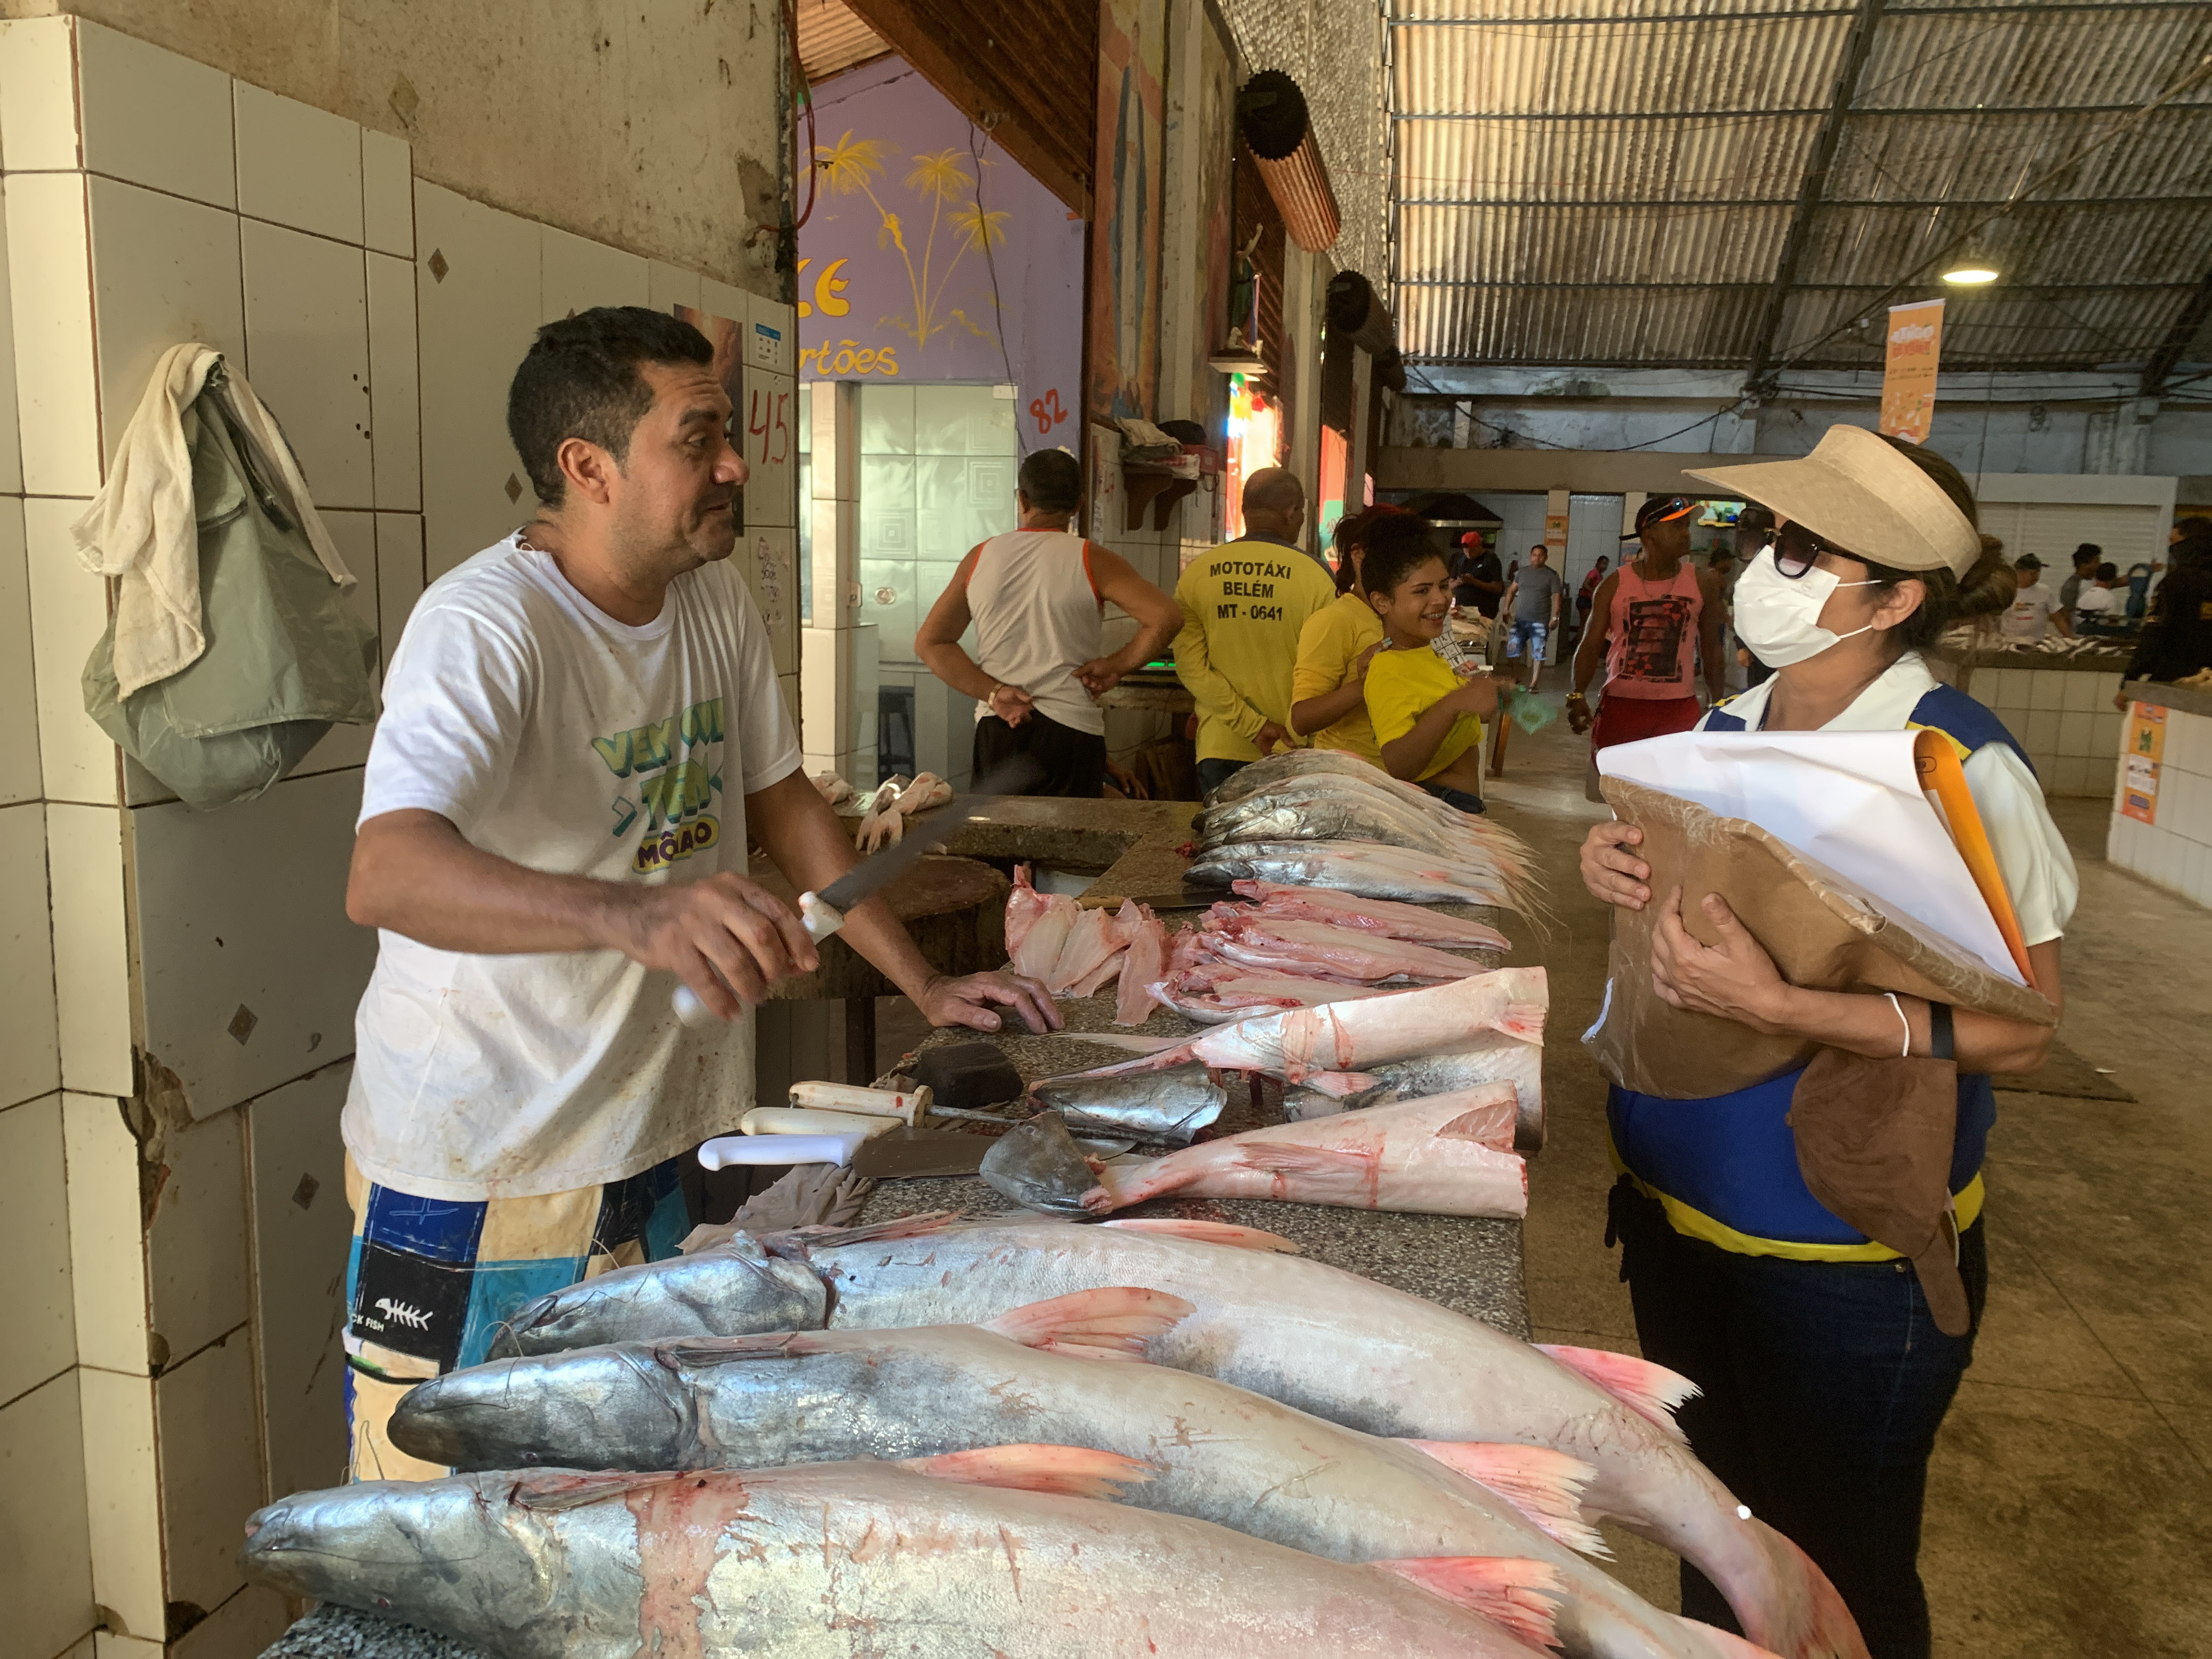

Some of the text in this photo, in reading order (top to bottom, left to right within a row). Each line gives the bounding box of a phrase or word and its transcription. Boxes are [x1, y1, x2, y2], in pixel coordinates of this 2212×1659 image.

[1029, 388, 1068, 434] 82
[749, 388, 789, 465] 45
[1210, 560, 1291, 579] MOTOTÁXI
[1223, 580, 1274, 598] BELÉM
[1217, 604, 1238, 619] MT
[1250, 605, 1282, 621] 0641
[365, 1317, 384, 1332] FISH
